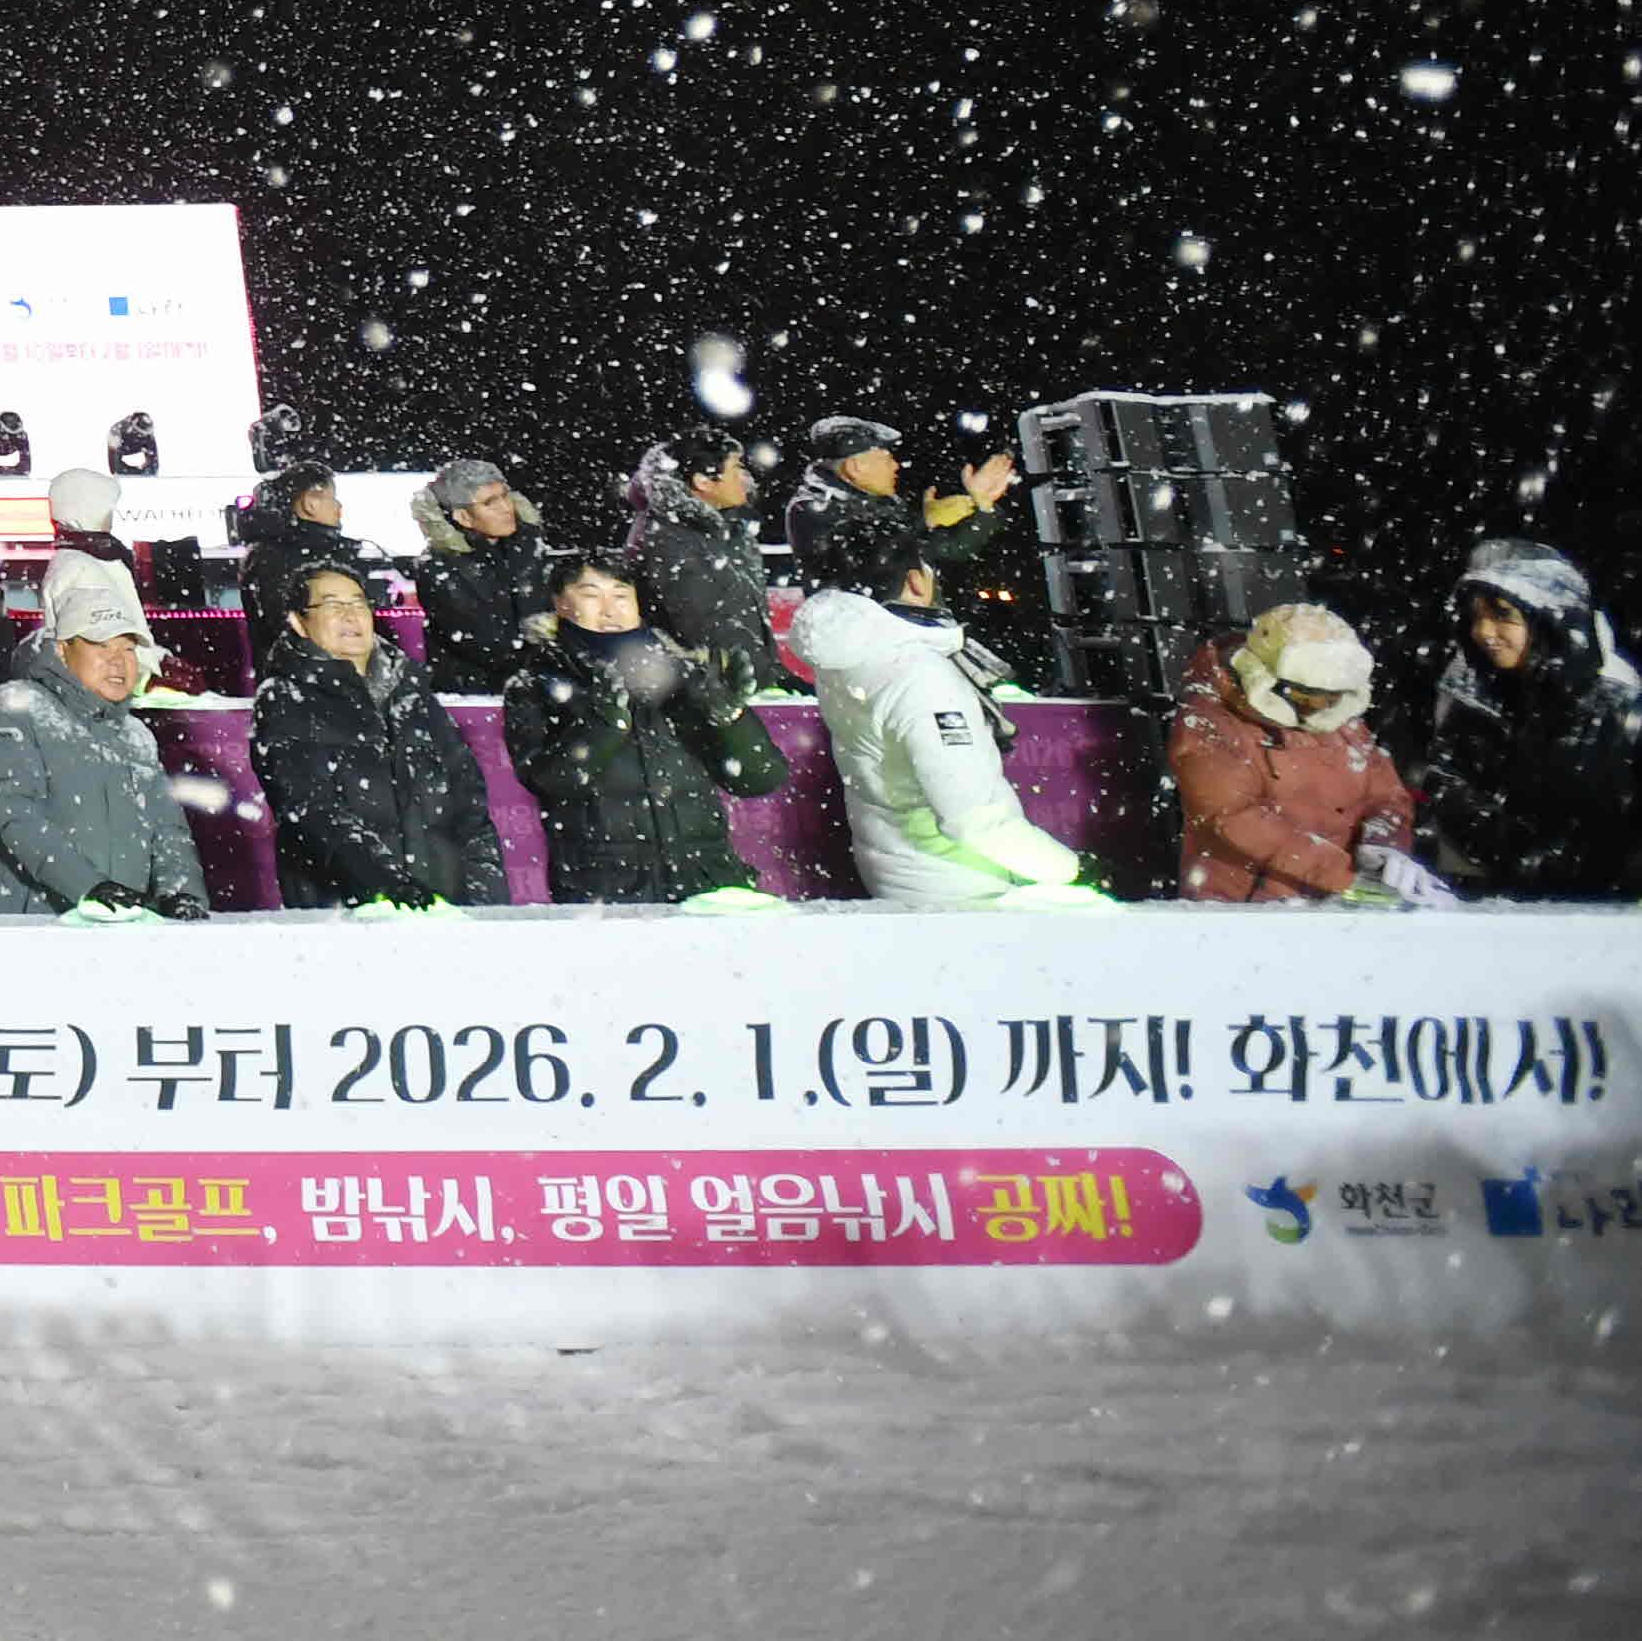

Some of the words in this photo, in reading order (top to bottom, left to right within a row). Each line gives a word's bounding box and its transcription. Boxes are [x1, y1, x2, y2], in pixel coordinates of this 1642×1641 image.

[126, 1022, 295, 1112] 부터
[329, 1022, 596, 1109] 2026.
[999, 1014, 1196, 1107] 까지!
[1228, 1014, 1611, 1108] 화천에서!
[300, 1174, 514, 1246] 밤낚시,
[538, 1172, 677, 1244] 평일
[690, 1170, 955, 1244] 얼음낚시
[973, 1168, 1137, 1244] 공짜!
[1338, 1179, 1443, 1221] 화천군
